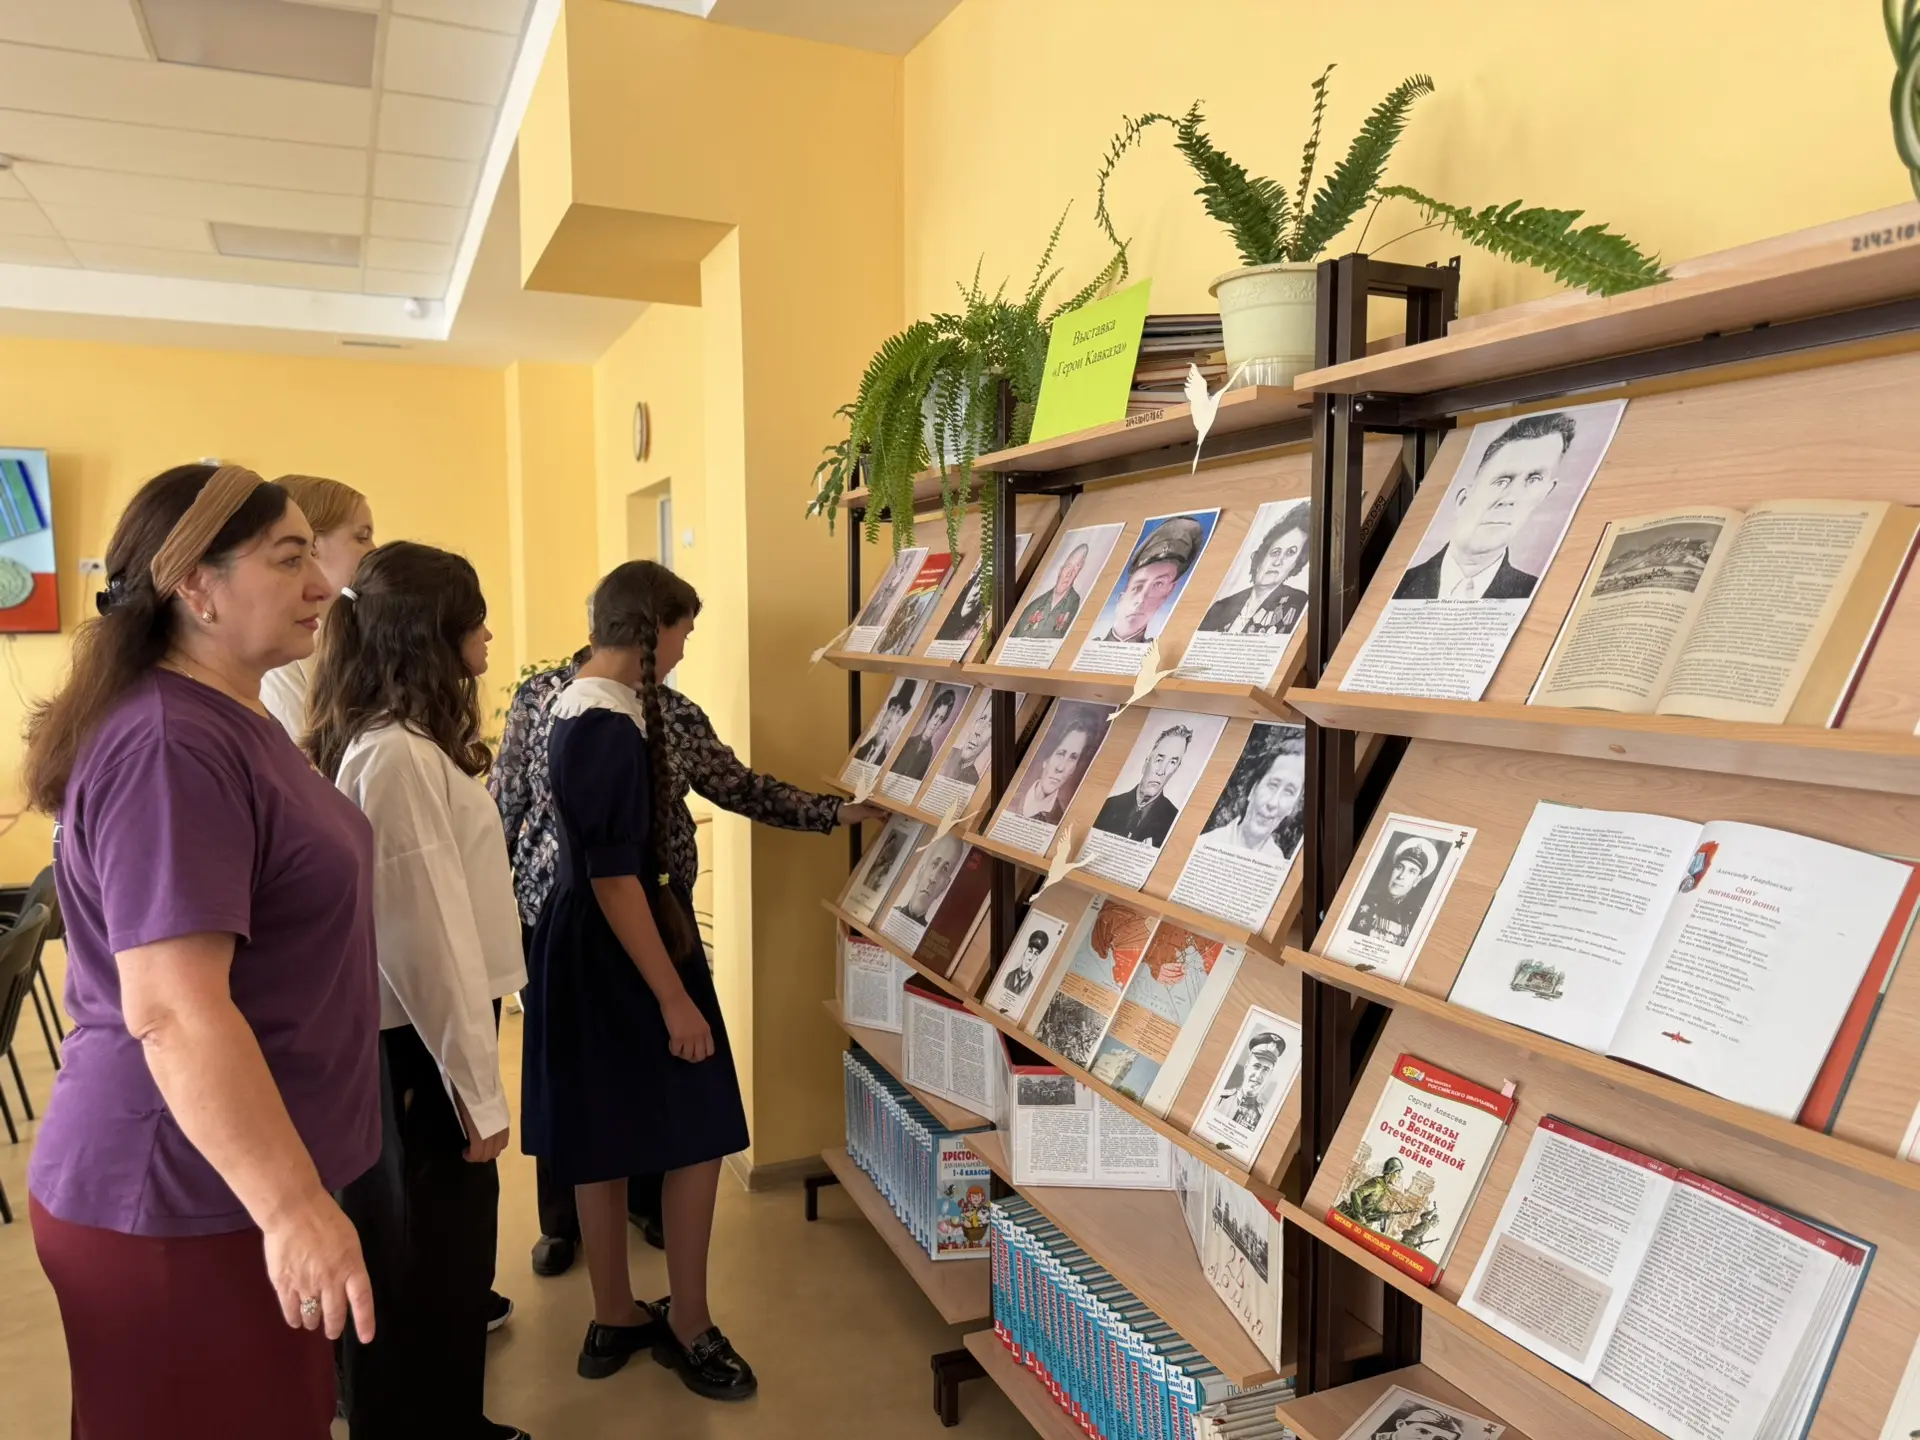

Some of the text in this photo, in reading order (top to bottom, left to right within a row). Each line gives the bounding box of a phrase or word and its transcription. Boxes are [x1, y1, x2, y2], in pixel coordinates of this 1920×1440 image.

[1073, 320, 1116, 346] Выставка
[1053, 342, 1127, 378] «Герои Кавказа»
[1708, 889, 1781, 913] ПОГИБШЕГО ВОИНА
[1736, 887, 1758, 897] СЫНУ
[1403, 1106, 1459, 1140] Рассказы
[1407, 1094, 1467, 1126] Сергей Алексеев
[1380, 1121, 1466, 1171] Отечественной
[1398, 1119, 1456, 1152] о Великой
[942, 1151, 980, 1162] ХРЕСТОМ
[1399, 1145, 1433, 1168] войне
[1110, 1339, 1121, 1411] ХРЕСТОМАТИЯ
[1119, 1351, 1129, 1423] ХРЕСТОМАТИЯ
[1131, 1361, 1143, 1435] ХРЕСТОМАТИЯ
[1143, 1372, 1155, 1440] РЕСТОМАТИЯ
[1153, 1384, 1164, 1440] СТОМАТИЯ
[1142, 1403, 1150, 1440] ЧАЛЬНОЙ
[1170, 1395, 1181, 1440] ОМАТИЯ
